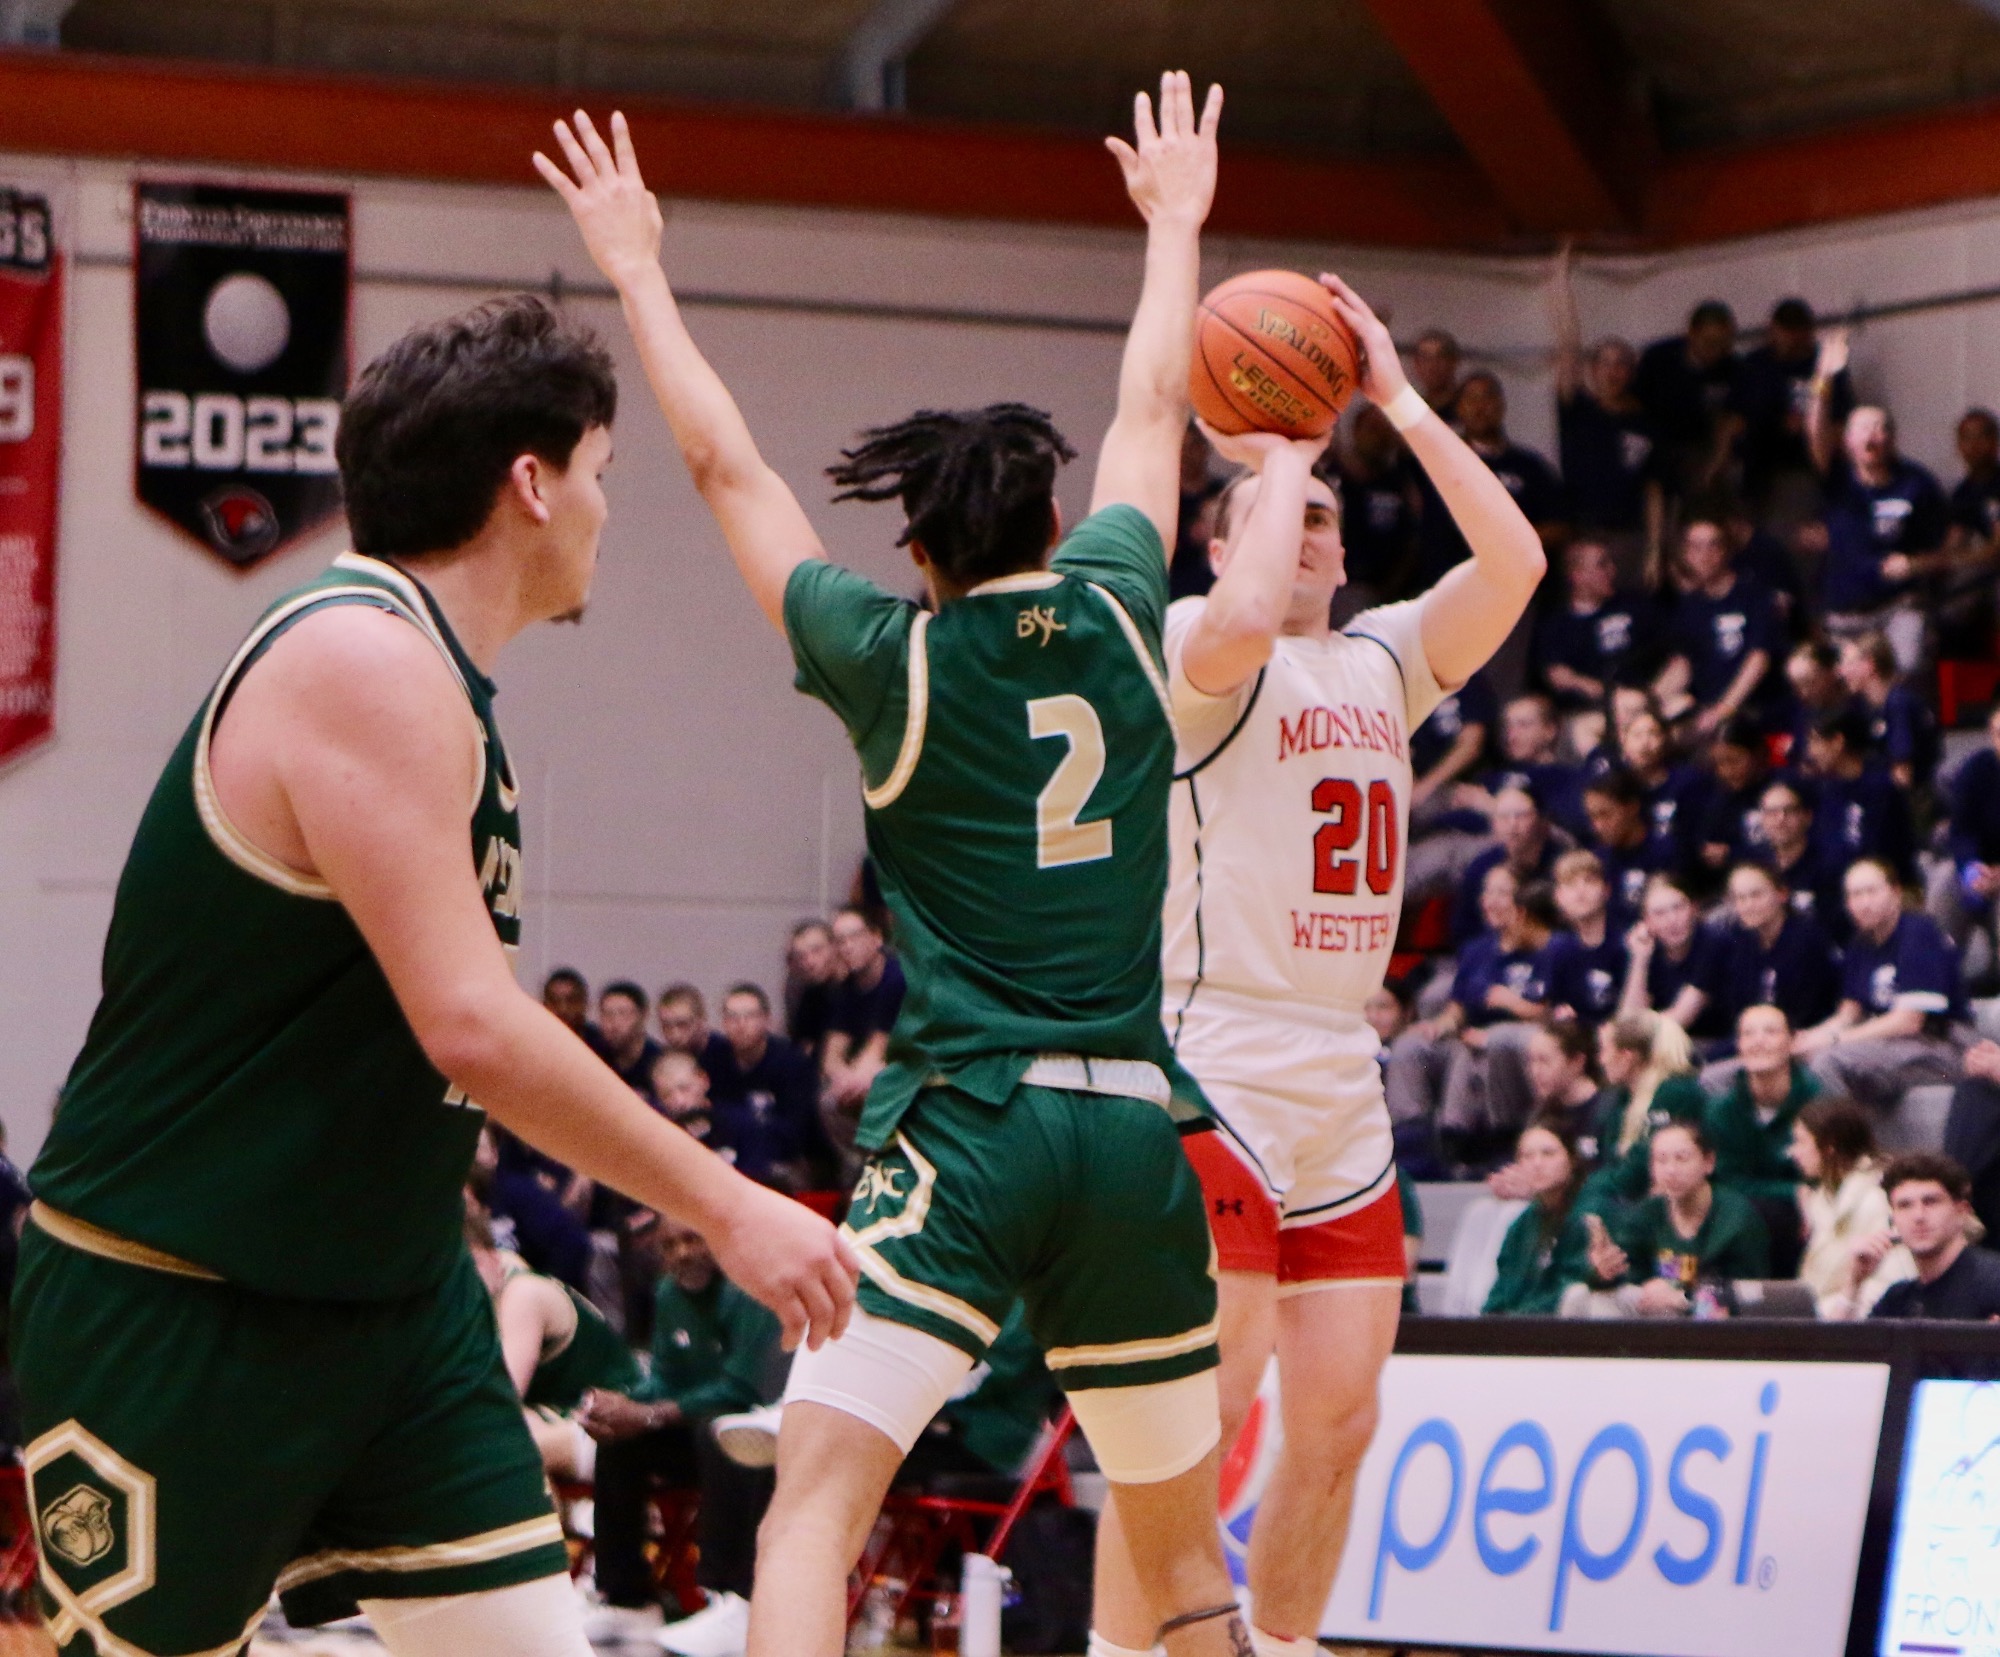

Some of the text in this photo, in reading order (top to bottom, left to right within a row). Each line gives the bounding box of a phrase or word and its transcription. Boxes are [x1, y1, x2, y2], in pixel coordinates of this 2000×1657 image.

[1252, 309, 1349, 397] SPALDING
[142, 391, 340, 472] 2023
[1027, 694, 1112, 869] 2
[1279, 703, 1405, 763] MONANA
[1312, 777, 1398, 895] 20
[1367, 1380, 1780, 1632] pepsi
